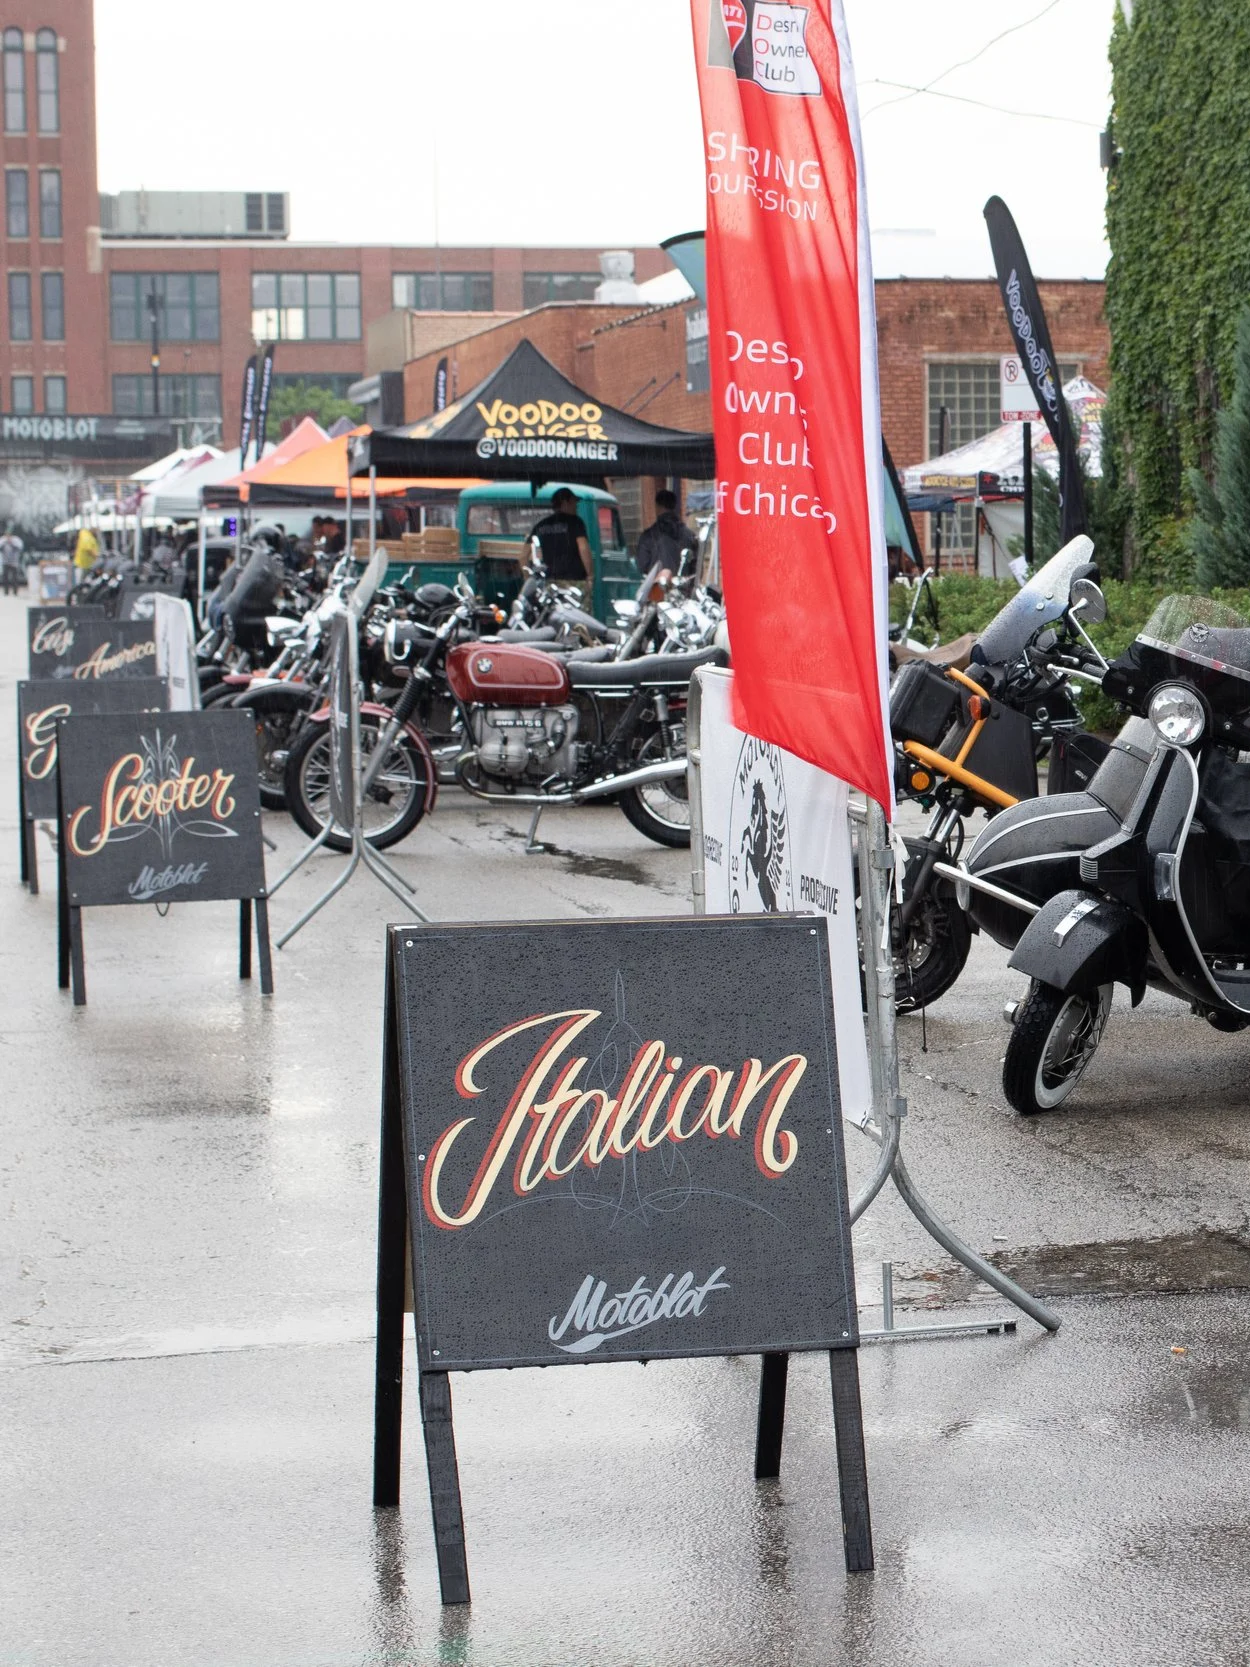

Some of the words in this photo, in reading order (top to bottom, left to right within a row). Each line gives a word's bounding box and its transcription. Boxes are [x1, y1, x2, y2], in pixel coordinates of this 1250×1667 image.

[707, 172, 757, 197] OUR
[2, 417, 100, 441] MOTOBLOT
[476, 398, 603, 427] VOODOO
[476, 436, 619, 461] @VOODOORANGER
[68, 752, 237, 857] Scooter
[128, 861, 208, 900] Motoblot
[422, 1008, 808, 1231] Italian
[548, 1265, 732, 1354] Motoblot
